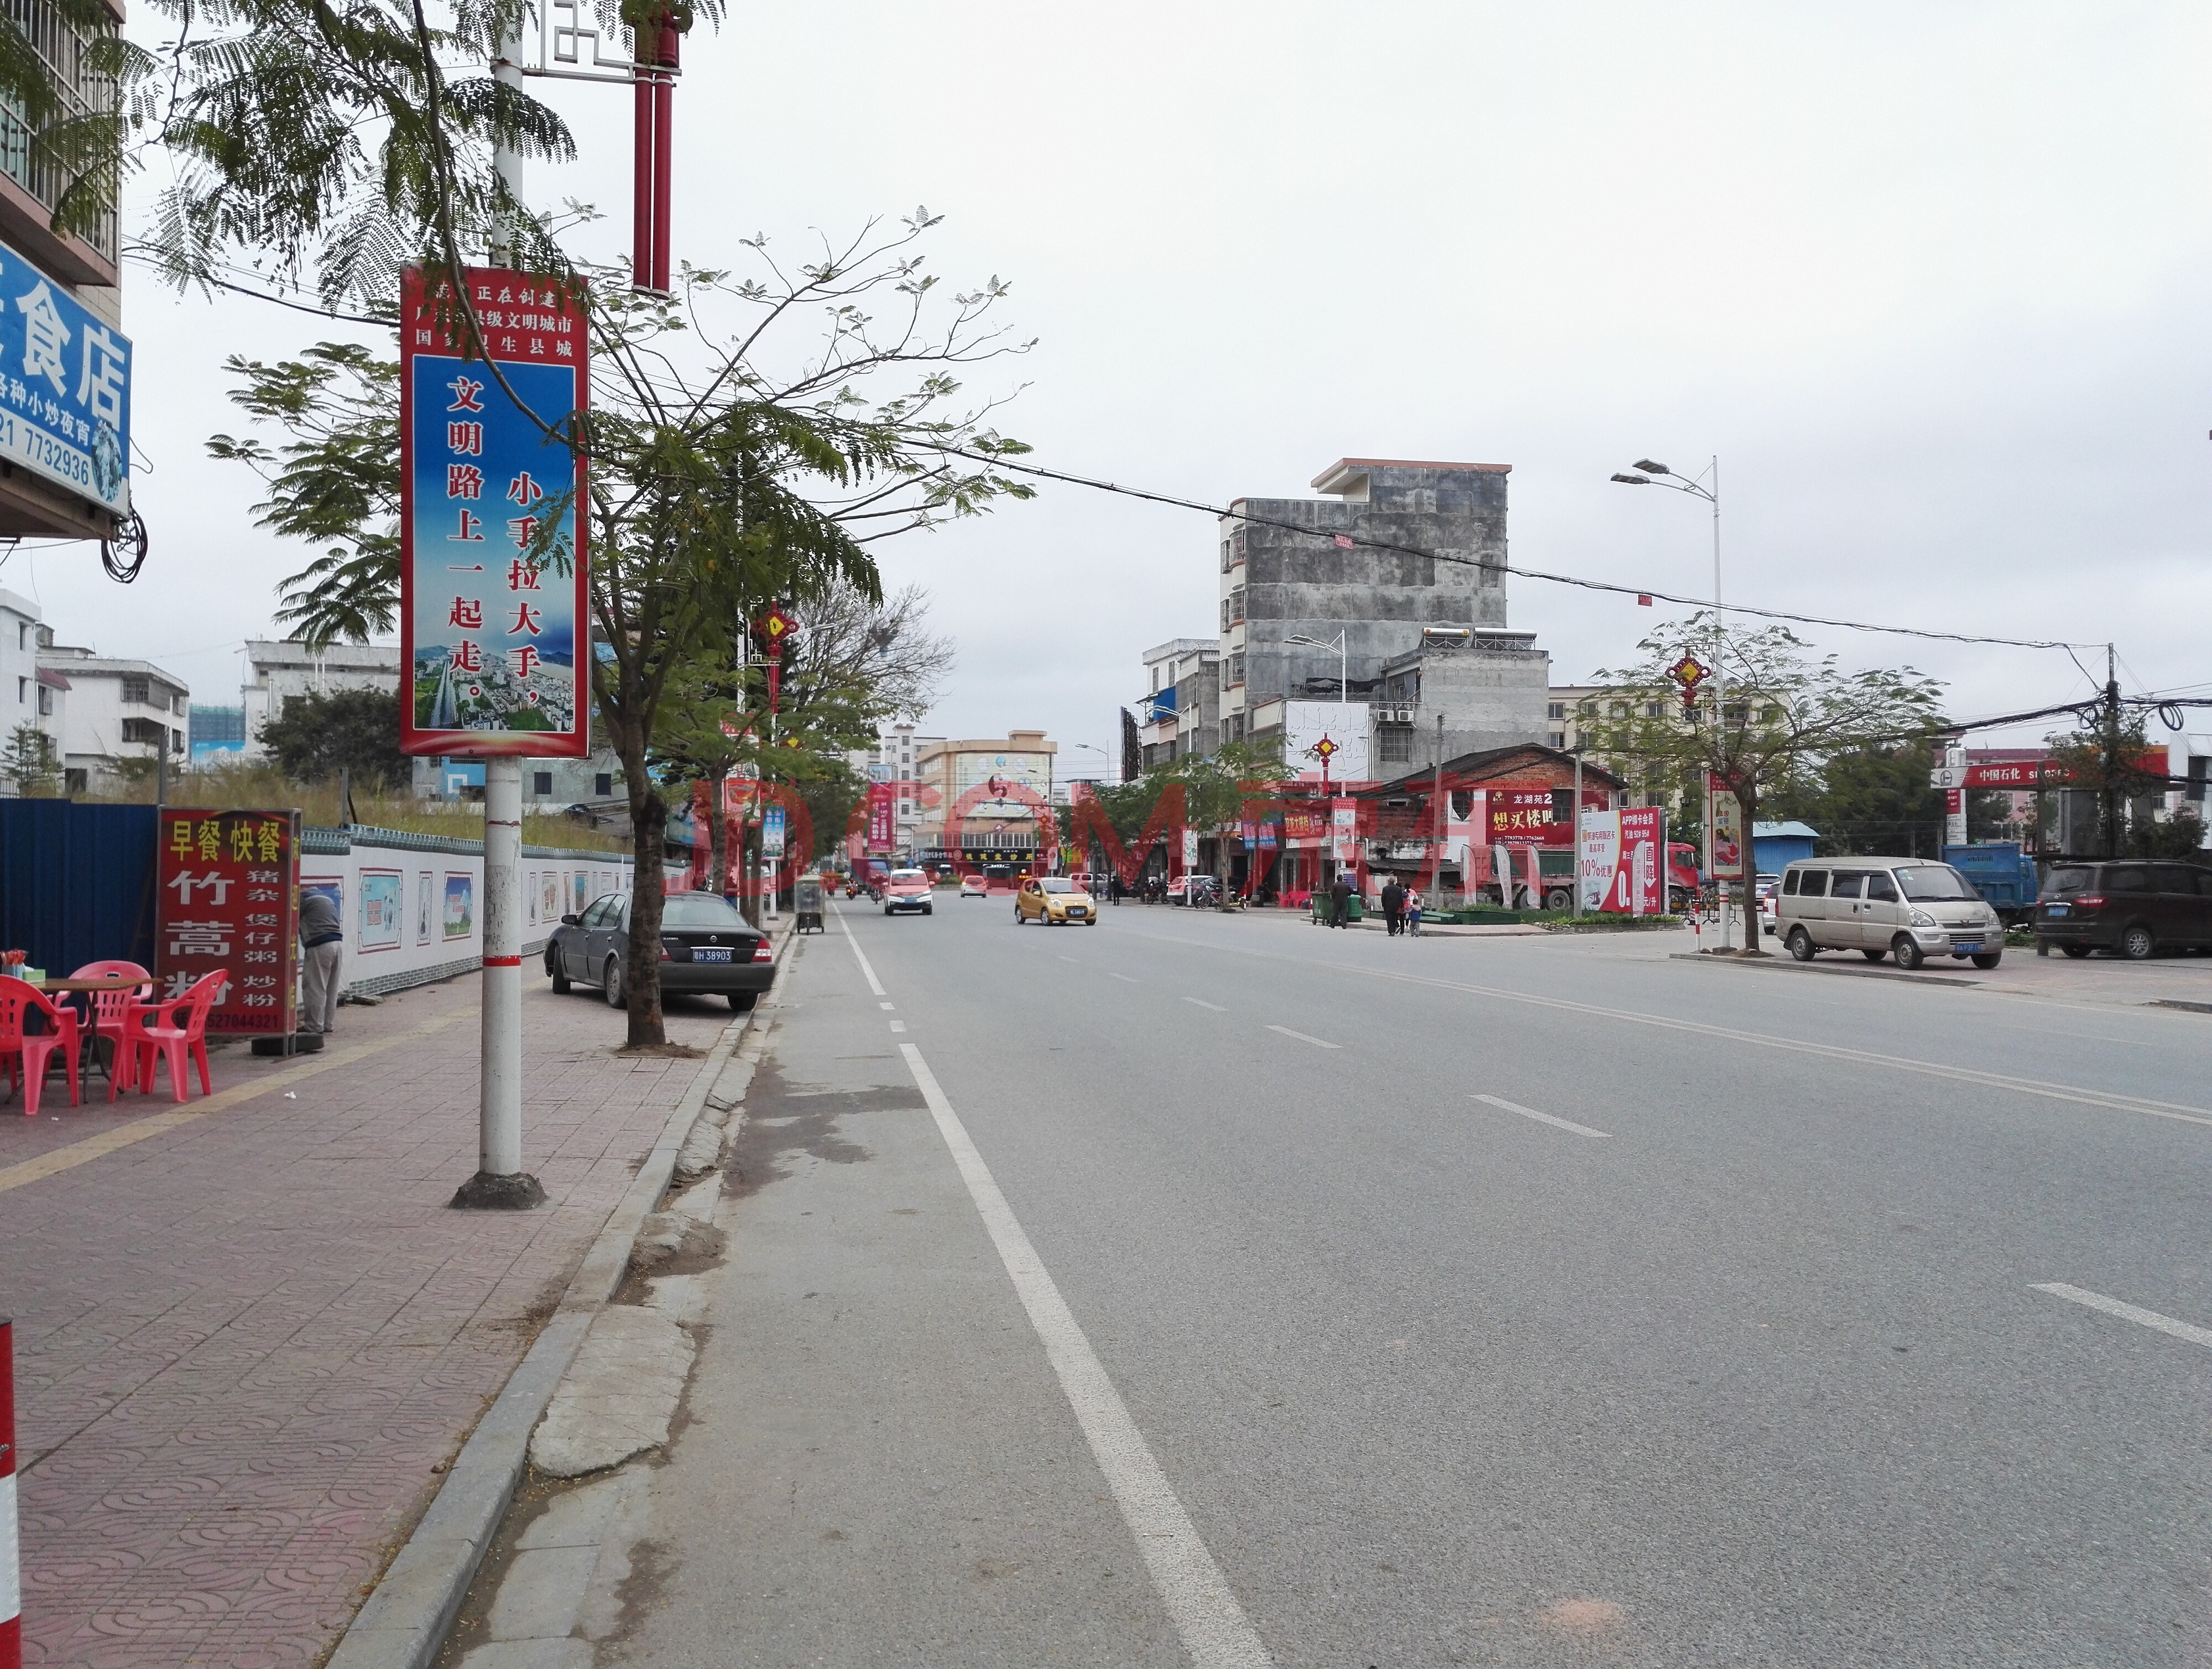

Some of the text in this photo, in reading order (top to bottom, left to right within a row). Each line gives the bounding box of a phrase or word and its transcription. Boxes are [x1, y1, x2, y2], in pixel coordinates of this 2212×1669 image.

[0, 263, 125, 432] 食店
[25, 427, 89, 486] 7732936
[1980, 768, 2070, 781] 中国石化 SIOPEC
[1621, 813, 1653, 826] APP绑卡会员
